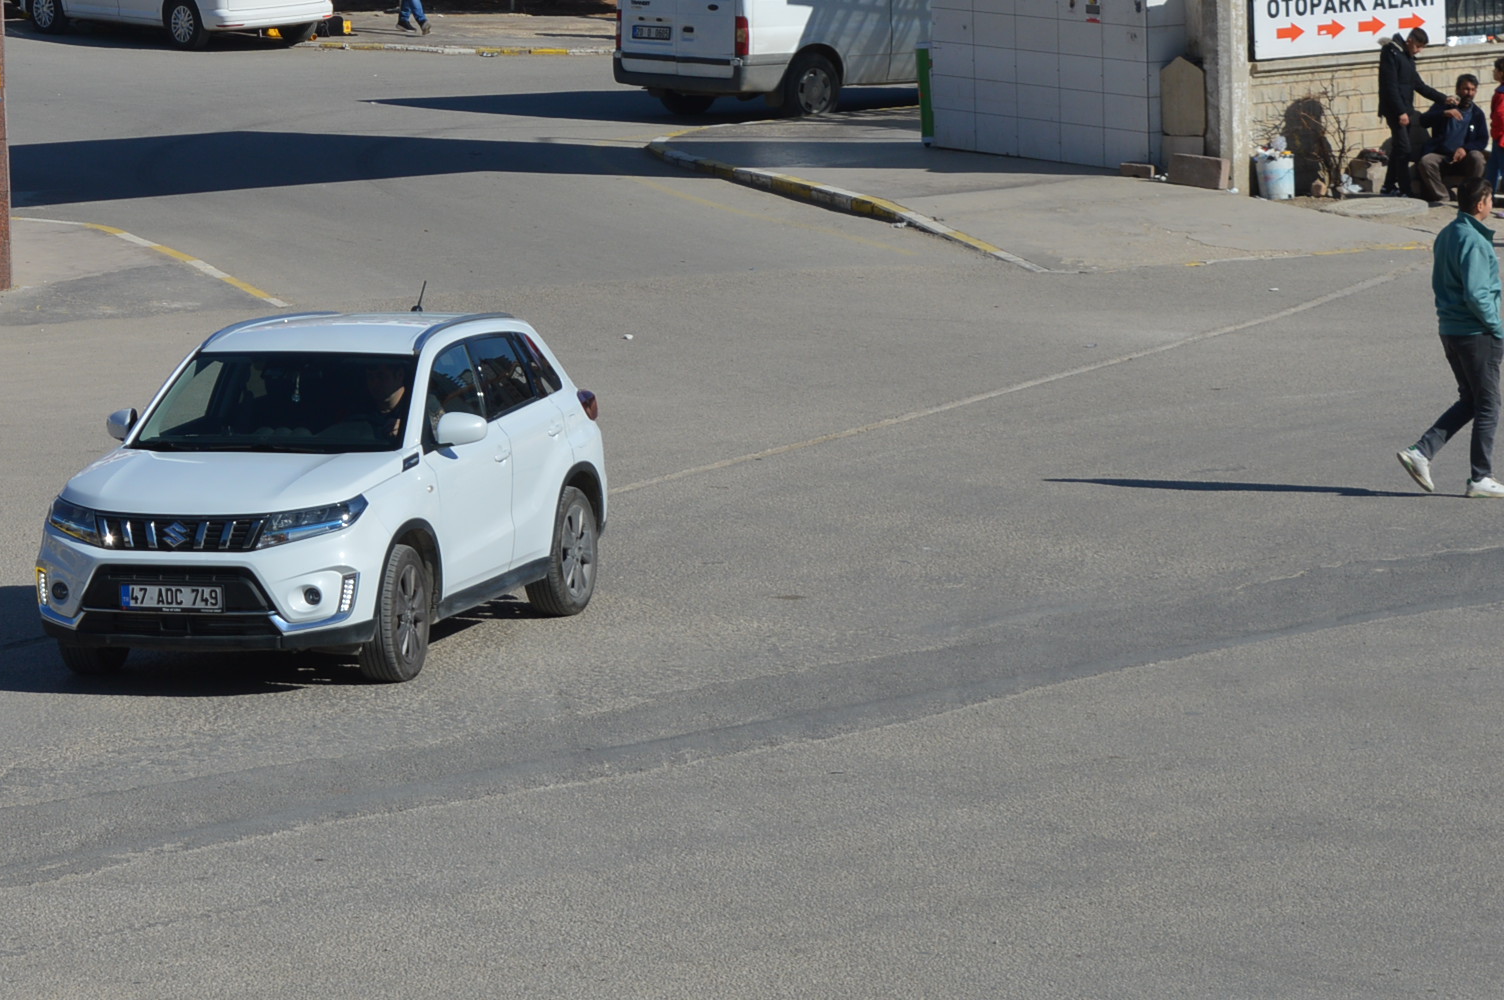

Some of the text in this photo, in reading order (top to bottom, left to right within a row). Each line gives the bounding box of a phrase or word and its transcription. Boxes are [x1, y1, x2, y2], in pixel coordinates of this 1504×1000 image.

[130, 587, 148, 605] 47
[156, 587, 183, 606] ADC
[191, 588, 219, 606] 749
